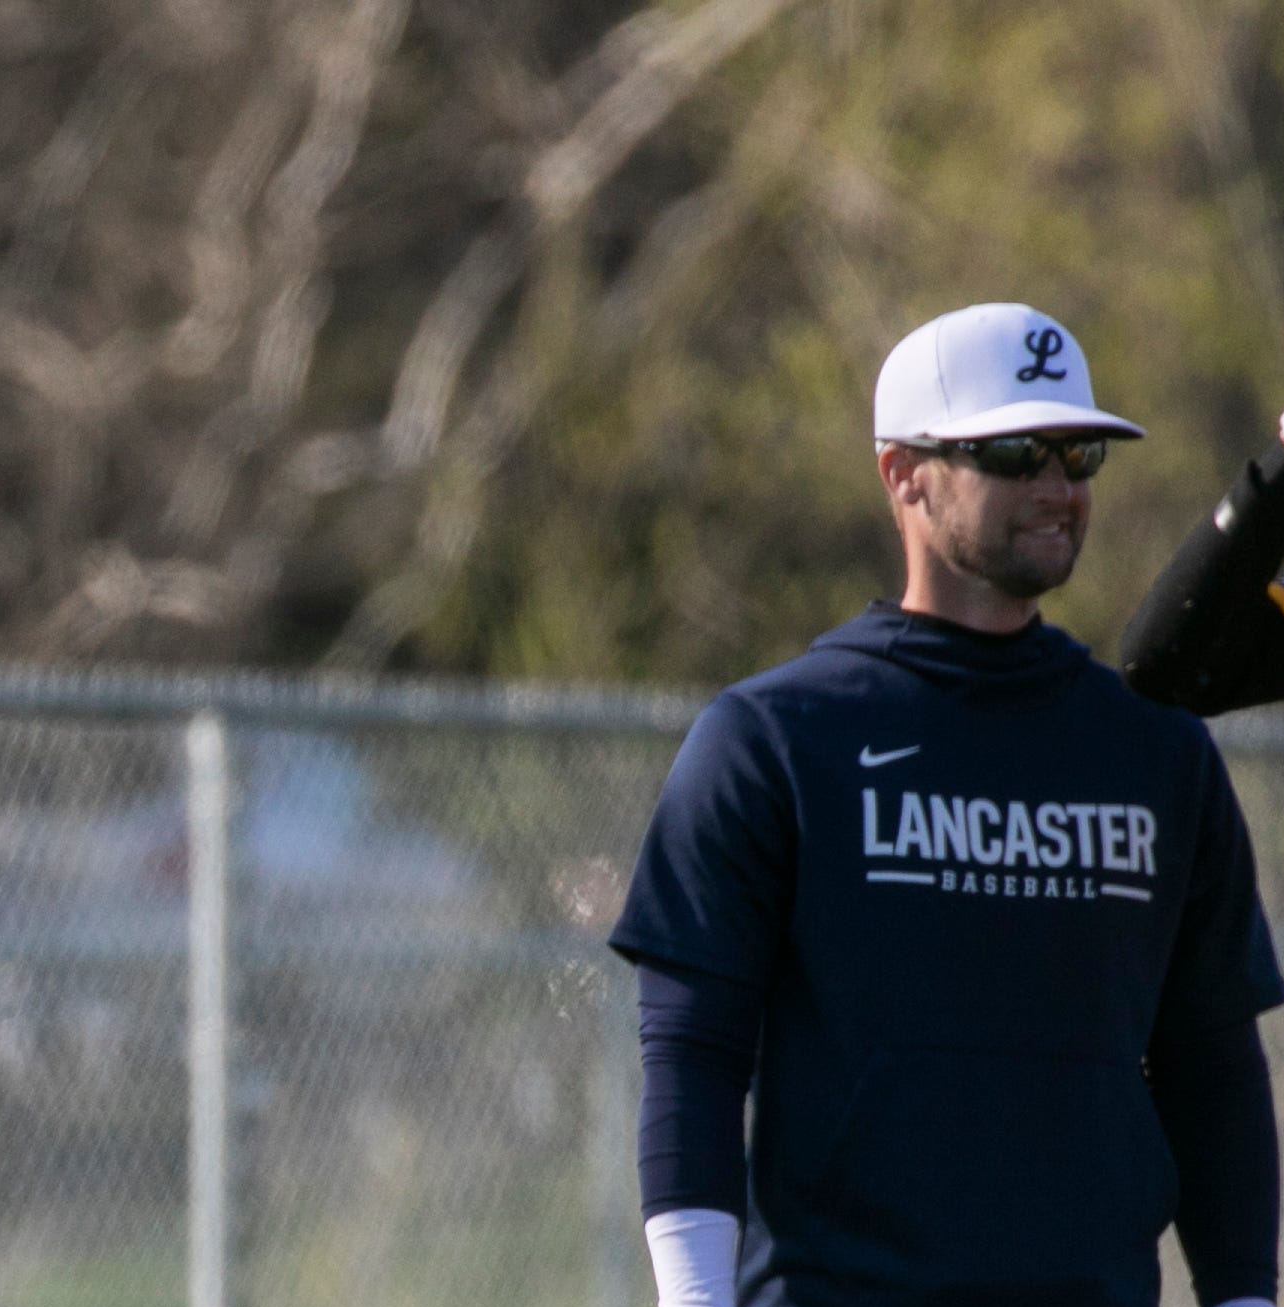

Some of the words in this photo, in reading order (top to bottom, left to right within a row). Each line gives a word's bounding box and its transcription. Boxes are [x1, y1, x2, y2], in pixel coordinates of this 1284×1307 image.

[1015, 328, 1068, 382] L
[863, 788, 1157, 876] LANCASTER
[941, 869, 1096, 899] BASEBALL
